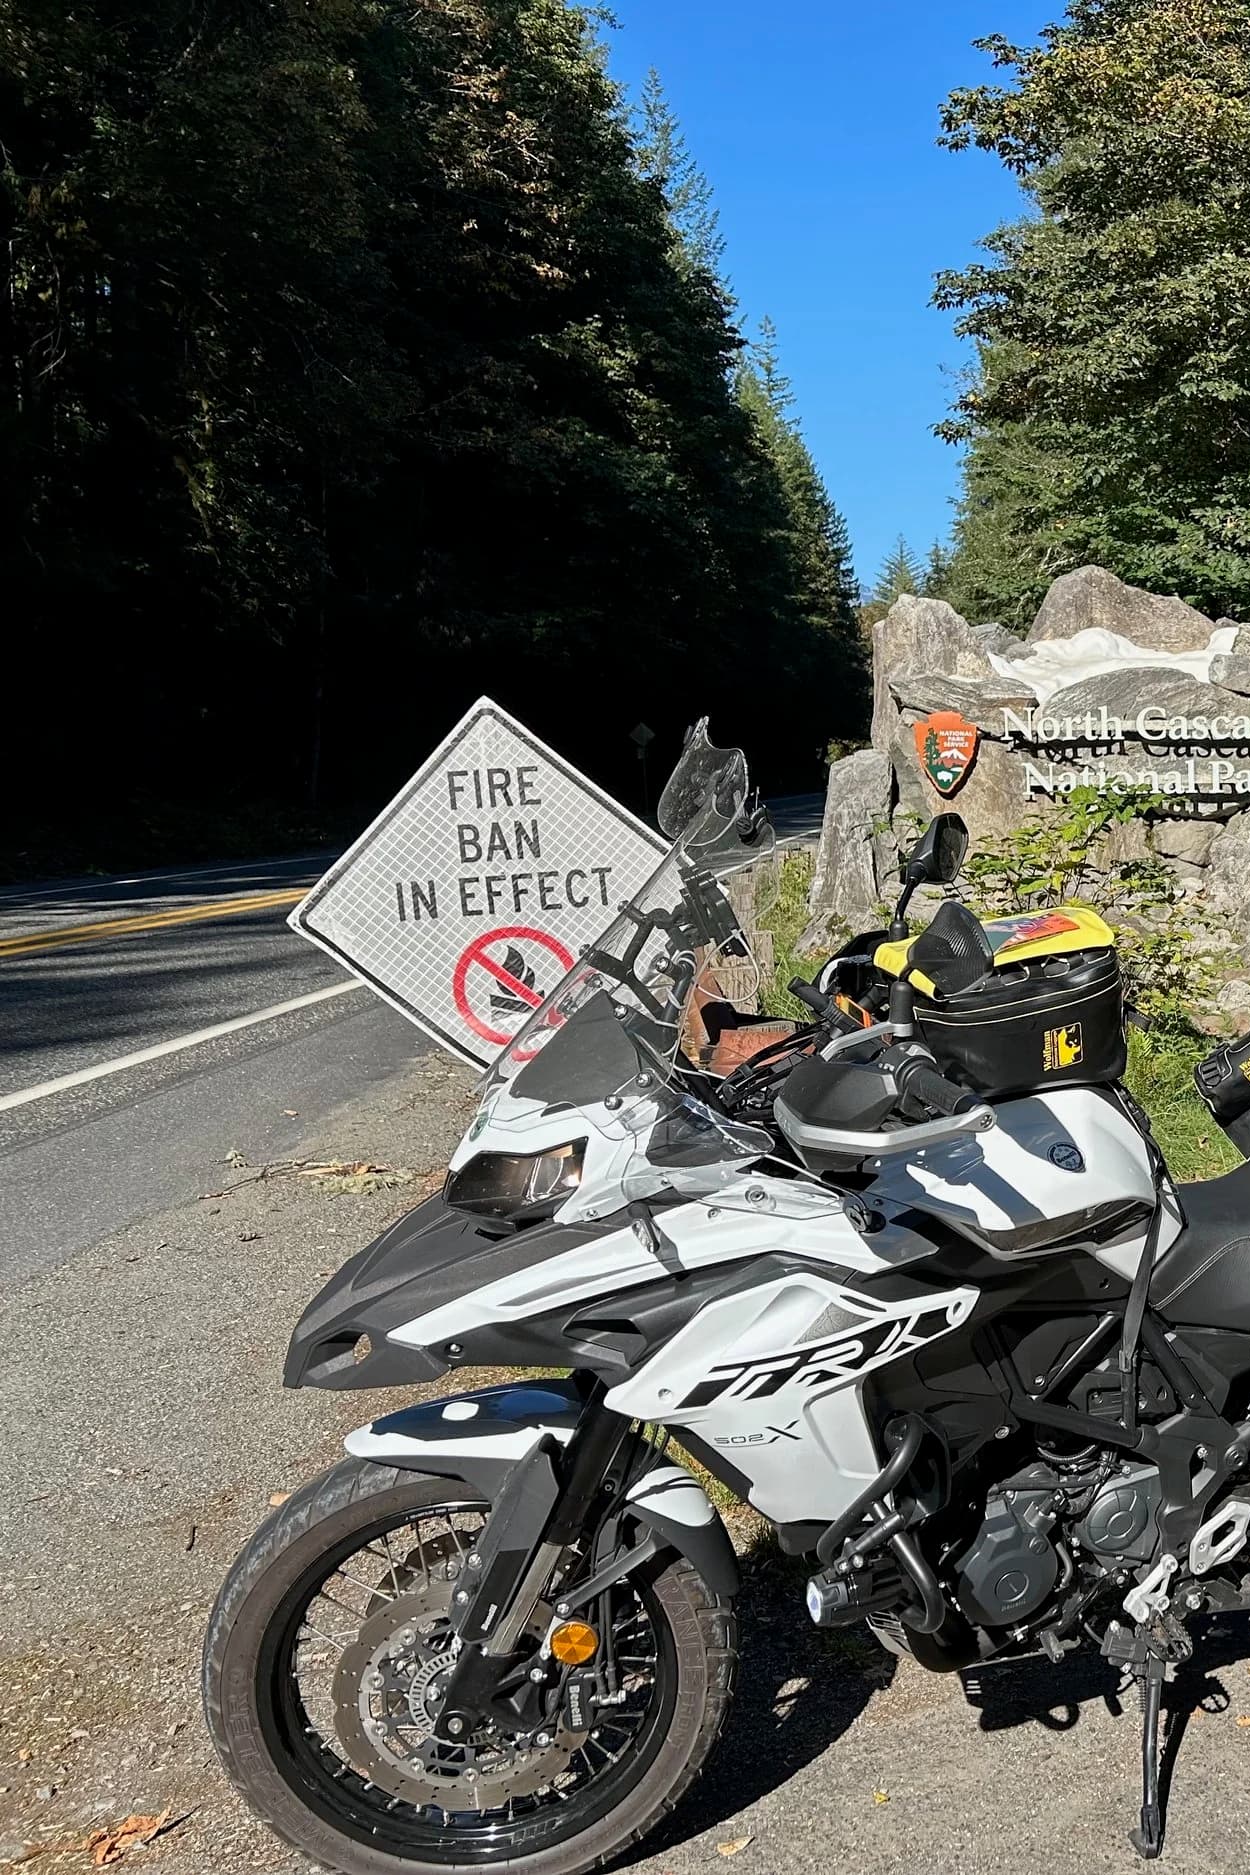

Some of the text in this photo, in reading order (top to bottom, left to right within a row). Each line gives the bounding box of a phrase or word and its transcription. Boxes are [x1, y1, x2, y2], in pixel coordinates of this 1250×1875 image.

[1000, 706, 1119, 741] North
[447, 766, 542, 811] FIRE
[1022, 758, 1198, 796] National
[457, 819, 542, 864] BAN
[396, 867, 613, 923] IN EFFECT
[1042, 1030, 1052, 1071] Wolfman
[569, 1684, 583, 1727] Benelli
